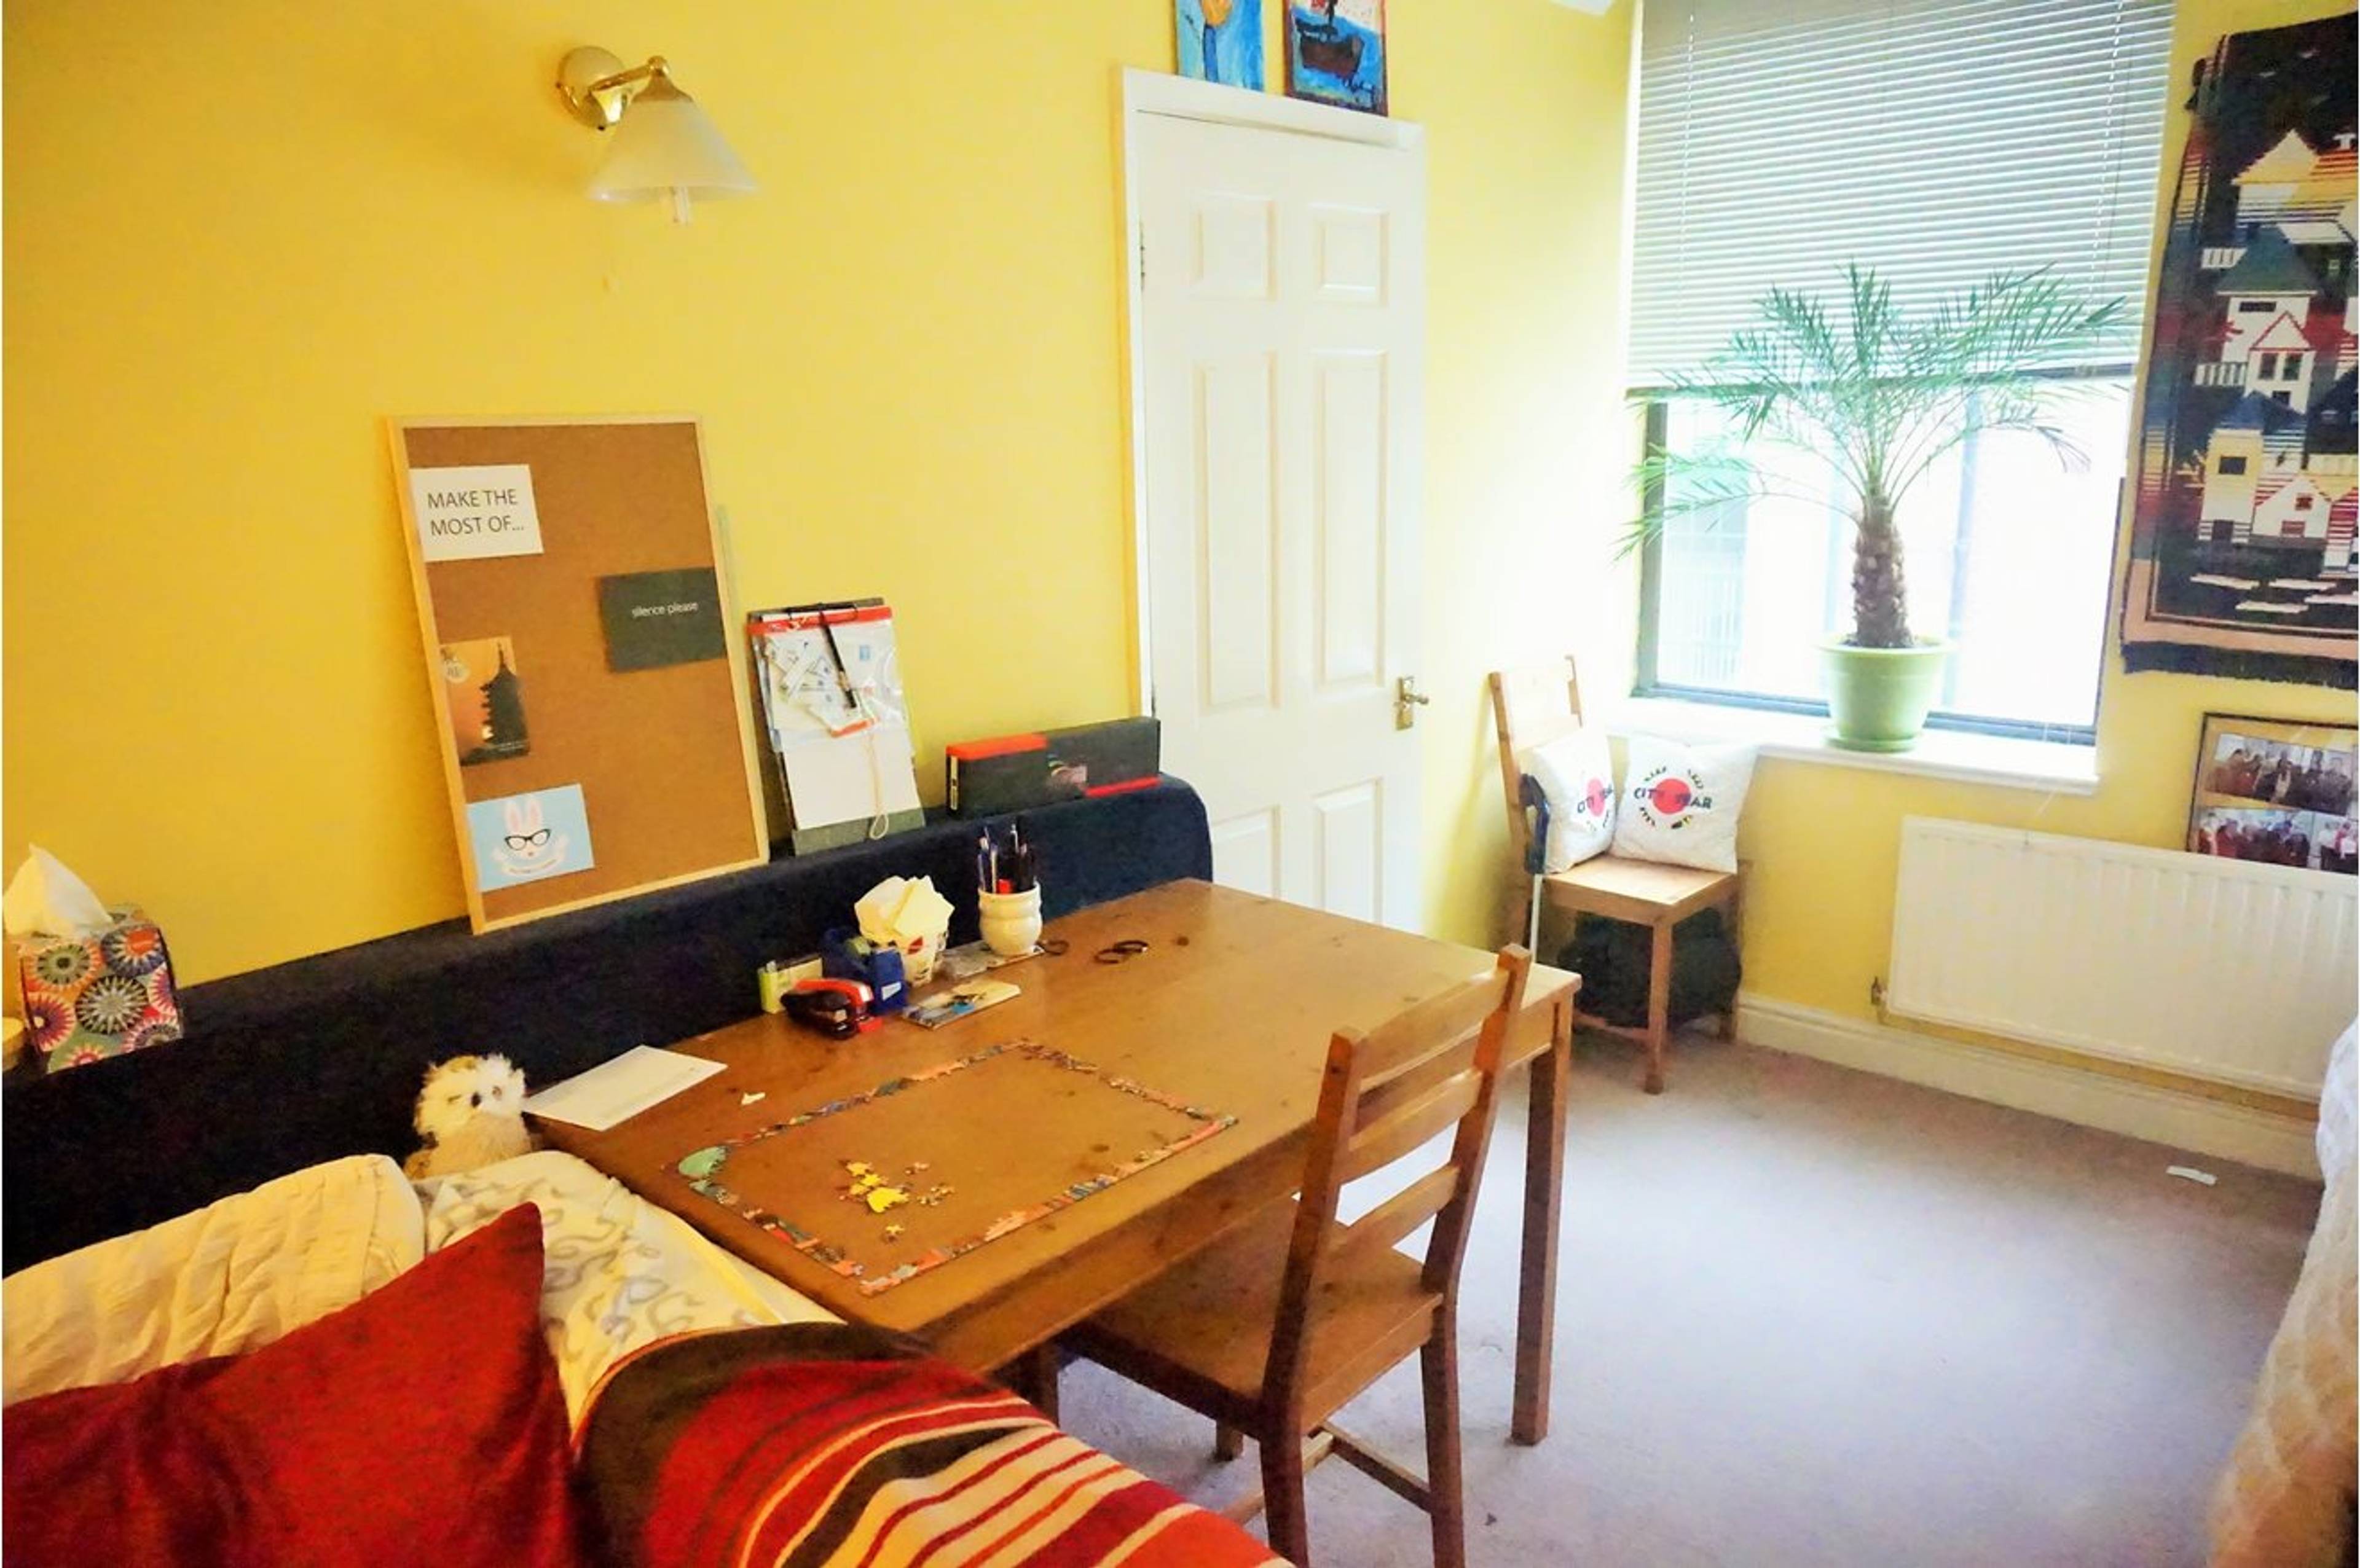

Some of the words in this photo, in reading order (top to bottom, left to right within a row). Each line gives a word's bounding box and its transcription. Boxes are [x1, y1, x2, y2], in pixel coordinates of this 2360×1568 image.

[427, 491, 480, 509] MAKE
[482, 488, 517, 506] THE
[431, 517, 482, 536] MOST
[489, 515, 524, 533] OF...
[631, 605, 665, 619] silence
[667, 602, 698, 616] please
